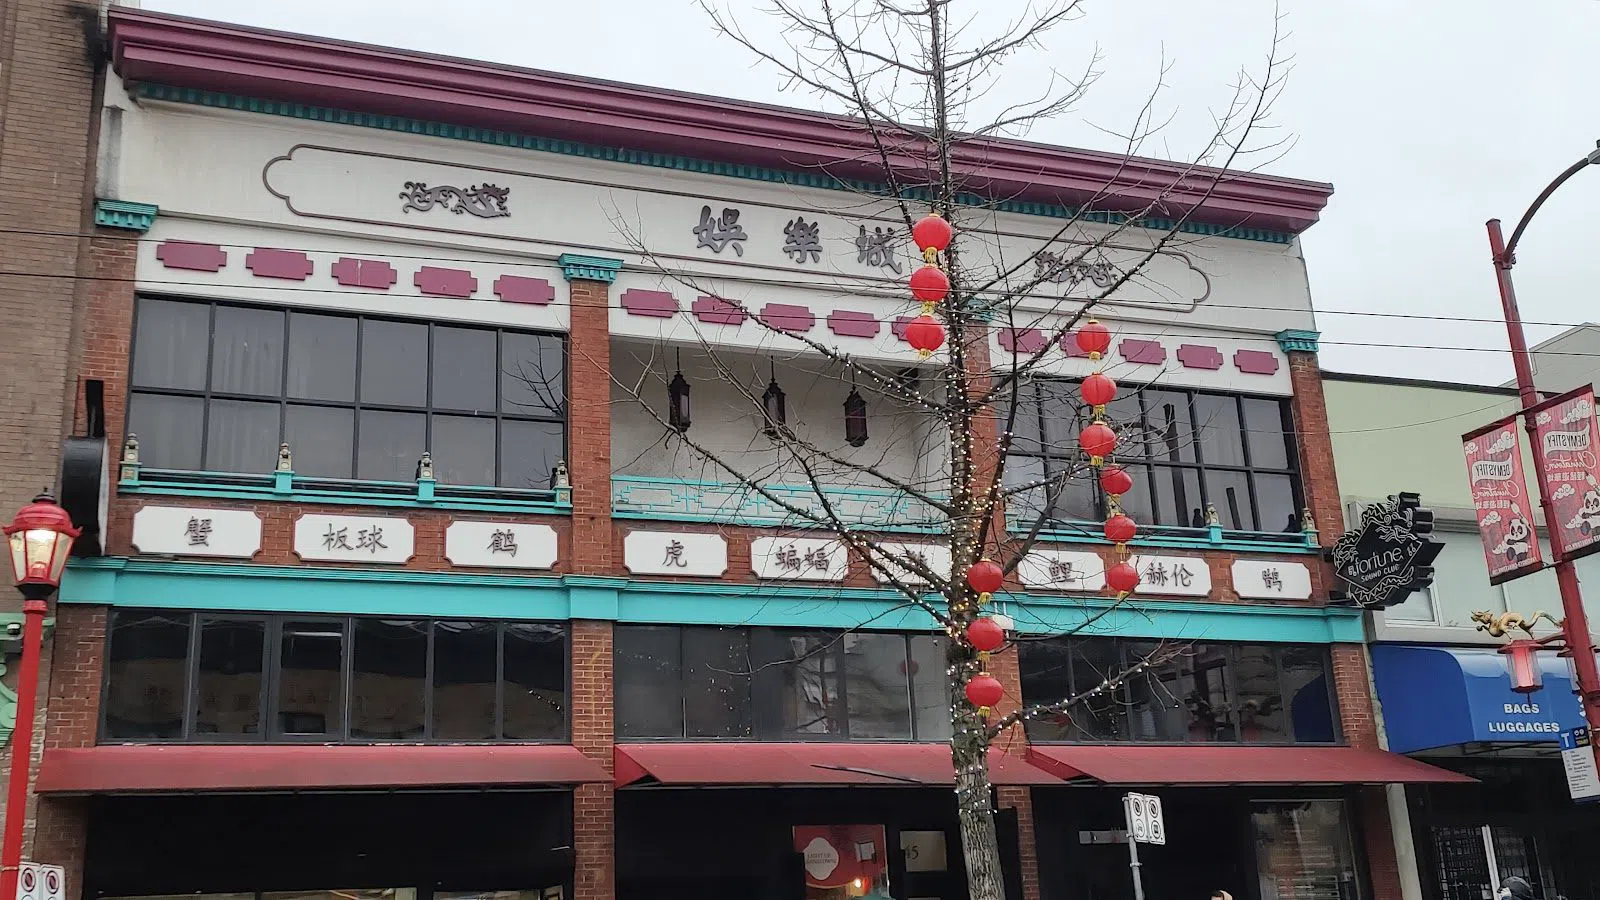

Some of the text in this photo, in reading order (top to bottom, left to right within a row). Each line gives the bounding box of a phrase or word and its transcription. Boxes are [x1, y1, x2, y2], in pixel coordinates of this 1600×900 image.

[184, 515, 213, 548] 蟹
[322, 523, 388, 554] 板球
[487, 528, 518, 557] 鹤
[661, 539, 688, 568] 虎
[775, 544, 830, 572] 蝙蝠
[1355, 547, 1404, 575] fortune
[1146, 562, 1194, 588] 赫伦
[1361, 569, 1382, 583] SOUND
[1503, 703, 1540, 714] BAGS
[1488, 722, 1560, 733] LUGGAGES
